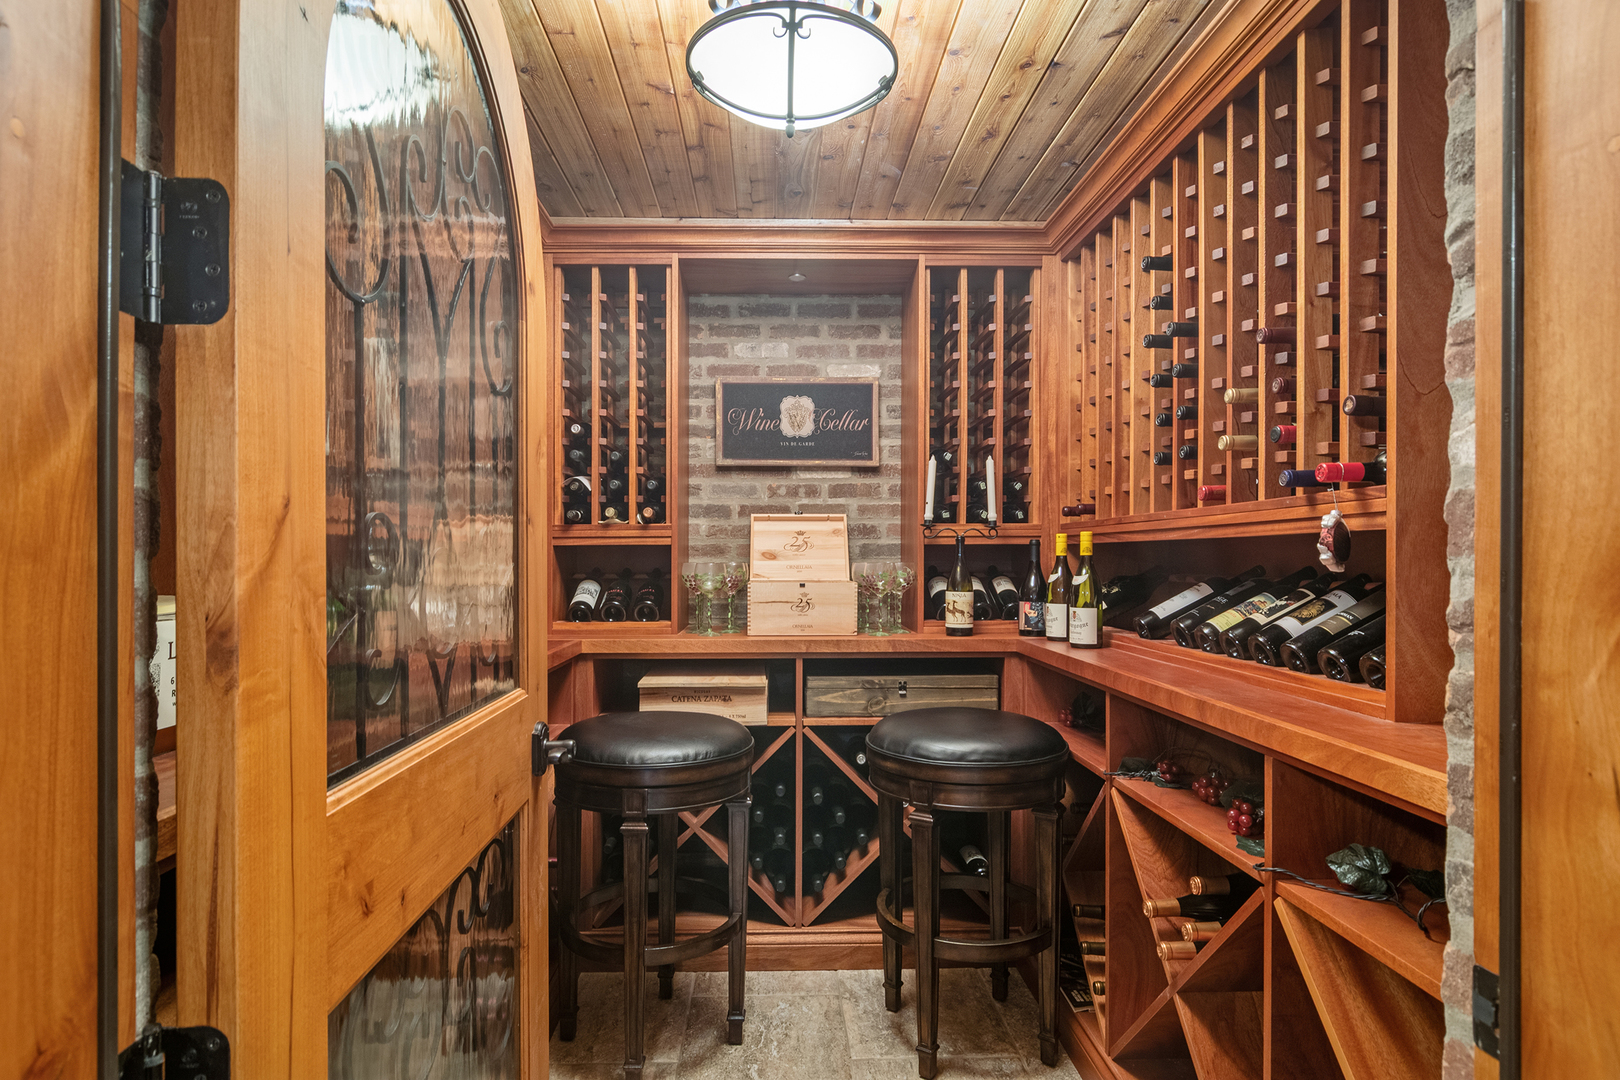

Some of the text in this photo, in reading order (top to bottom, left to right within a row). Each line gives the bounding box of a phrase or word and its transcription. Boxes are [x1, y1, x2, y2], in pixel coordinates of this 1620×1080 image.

[727, 407, 869, 436] Wine Cellar
[785, 536, 812, 553] 25
[792, 597, 814, 613] 25
[671, 695, 733, 703] CATENA ZAPATA
